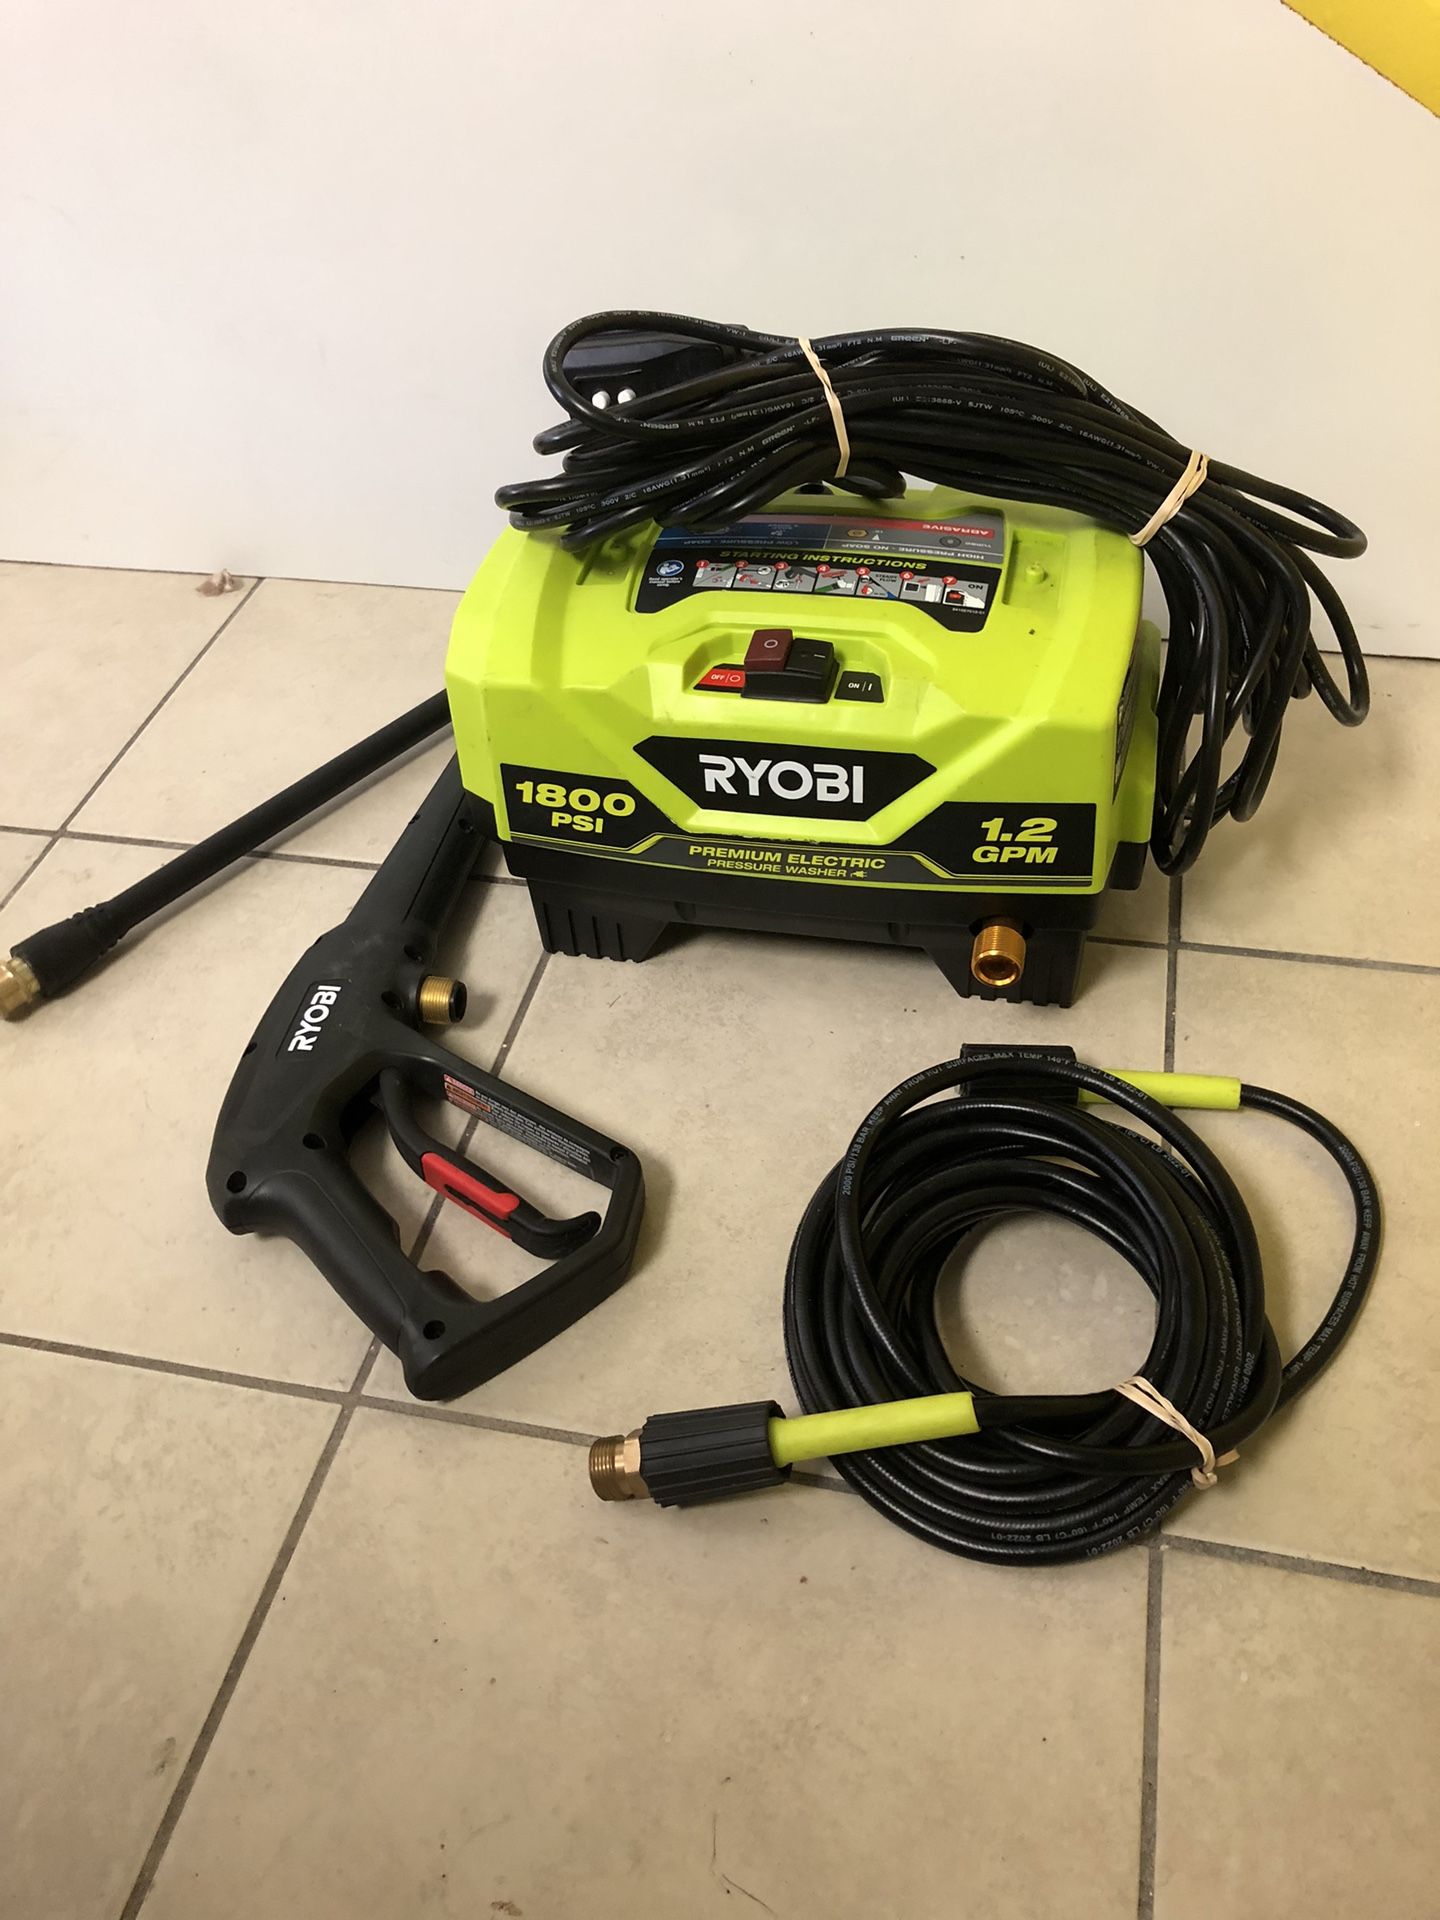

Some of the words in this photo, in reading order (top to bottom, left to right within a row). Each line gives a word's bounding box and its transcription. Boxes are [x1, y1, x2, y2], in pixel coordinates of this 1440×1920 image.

[1030, 413, 1055, 426] 300V
[921, 523, 990, 536] ABRASIVE
[841, 542, 870, 551] SOAP
[873, 544, 889, 552] NO
[898, 545, 956, 557] PRESSURE
[957, 552, 985, 560] HIGH
[719, 549, 799, 564] STARTING
[801, 552, 928, 571] INSTRUCTIONS
[968, 583, 984, 591] ON
[698, 753, 865, 804] RYOBI
[515, 780, 637, 817] 1800
[551, 812, 605, 834] PSI
[979, 816, 1058, 842] 1.2
[688, 845, 781, 863] PREMIUM
[786, 852, 887, 870] ELECTRIC
[970, 845, 1059, 865] GPM
[707, 858, 782, 873] PRESSURE
[785, 865, 848, 878] WASHER
[287, 984, 343, 1052] RYOBI
[841, 1175, 853, 1196] 2000
[856, 1126, 870, 1145] BAR
[868, 1105, 885, 1127] KEEP
[883, 1088, 904, 1107] AWAY
[903, 1073, 928, 1090] FROM
[1018, 1050, 1043, 1060] TEMP
[1242, 1351, 1256, 1375] 2000
[1122, 1491, 1149, 1514] TEMP
[990, 1531, 1032, 1543] 2022-01
[1034, 1532, 1052, 1542] LB
[1125, 1524, 1142, 1541] LB
